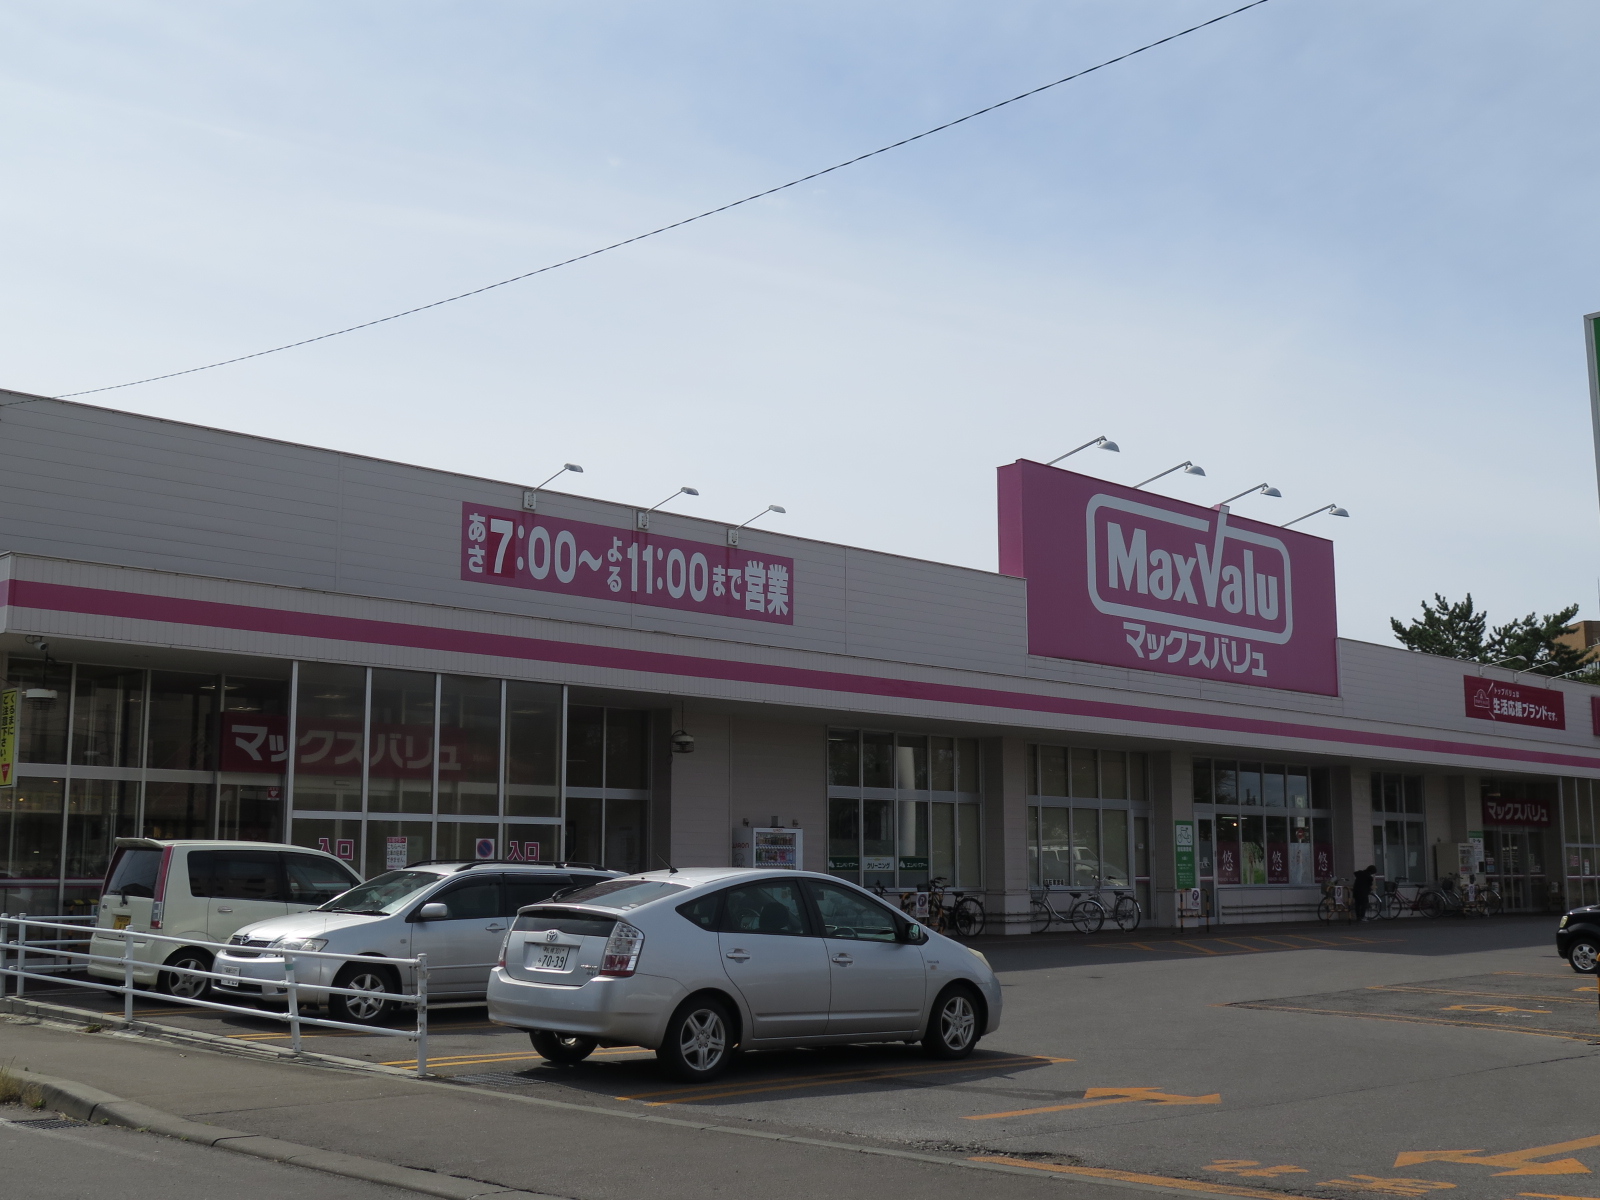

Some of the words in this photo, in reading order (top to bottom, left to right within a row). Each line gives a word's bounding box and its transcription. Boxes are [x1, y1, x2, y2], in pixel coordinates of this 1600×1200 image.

[1107, 516, 1279, 621] MaxValu
[1122, 621, 1268, 678] マックスバリュ
[231, 724, 462, 771] マックスバリュ
[1487, 801, 1549, 822] マックスバリュ
[318, 837, 355, 862] 入口
[508, 840, 540, 862] 入口
[866, 862, 891, 870] クリーニング
[541, 954, 565, 968] 70-39
